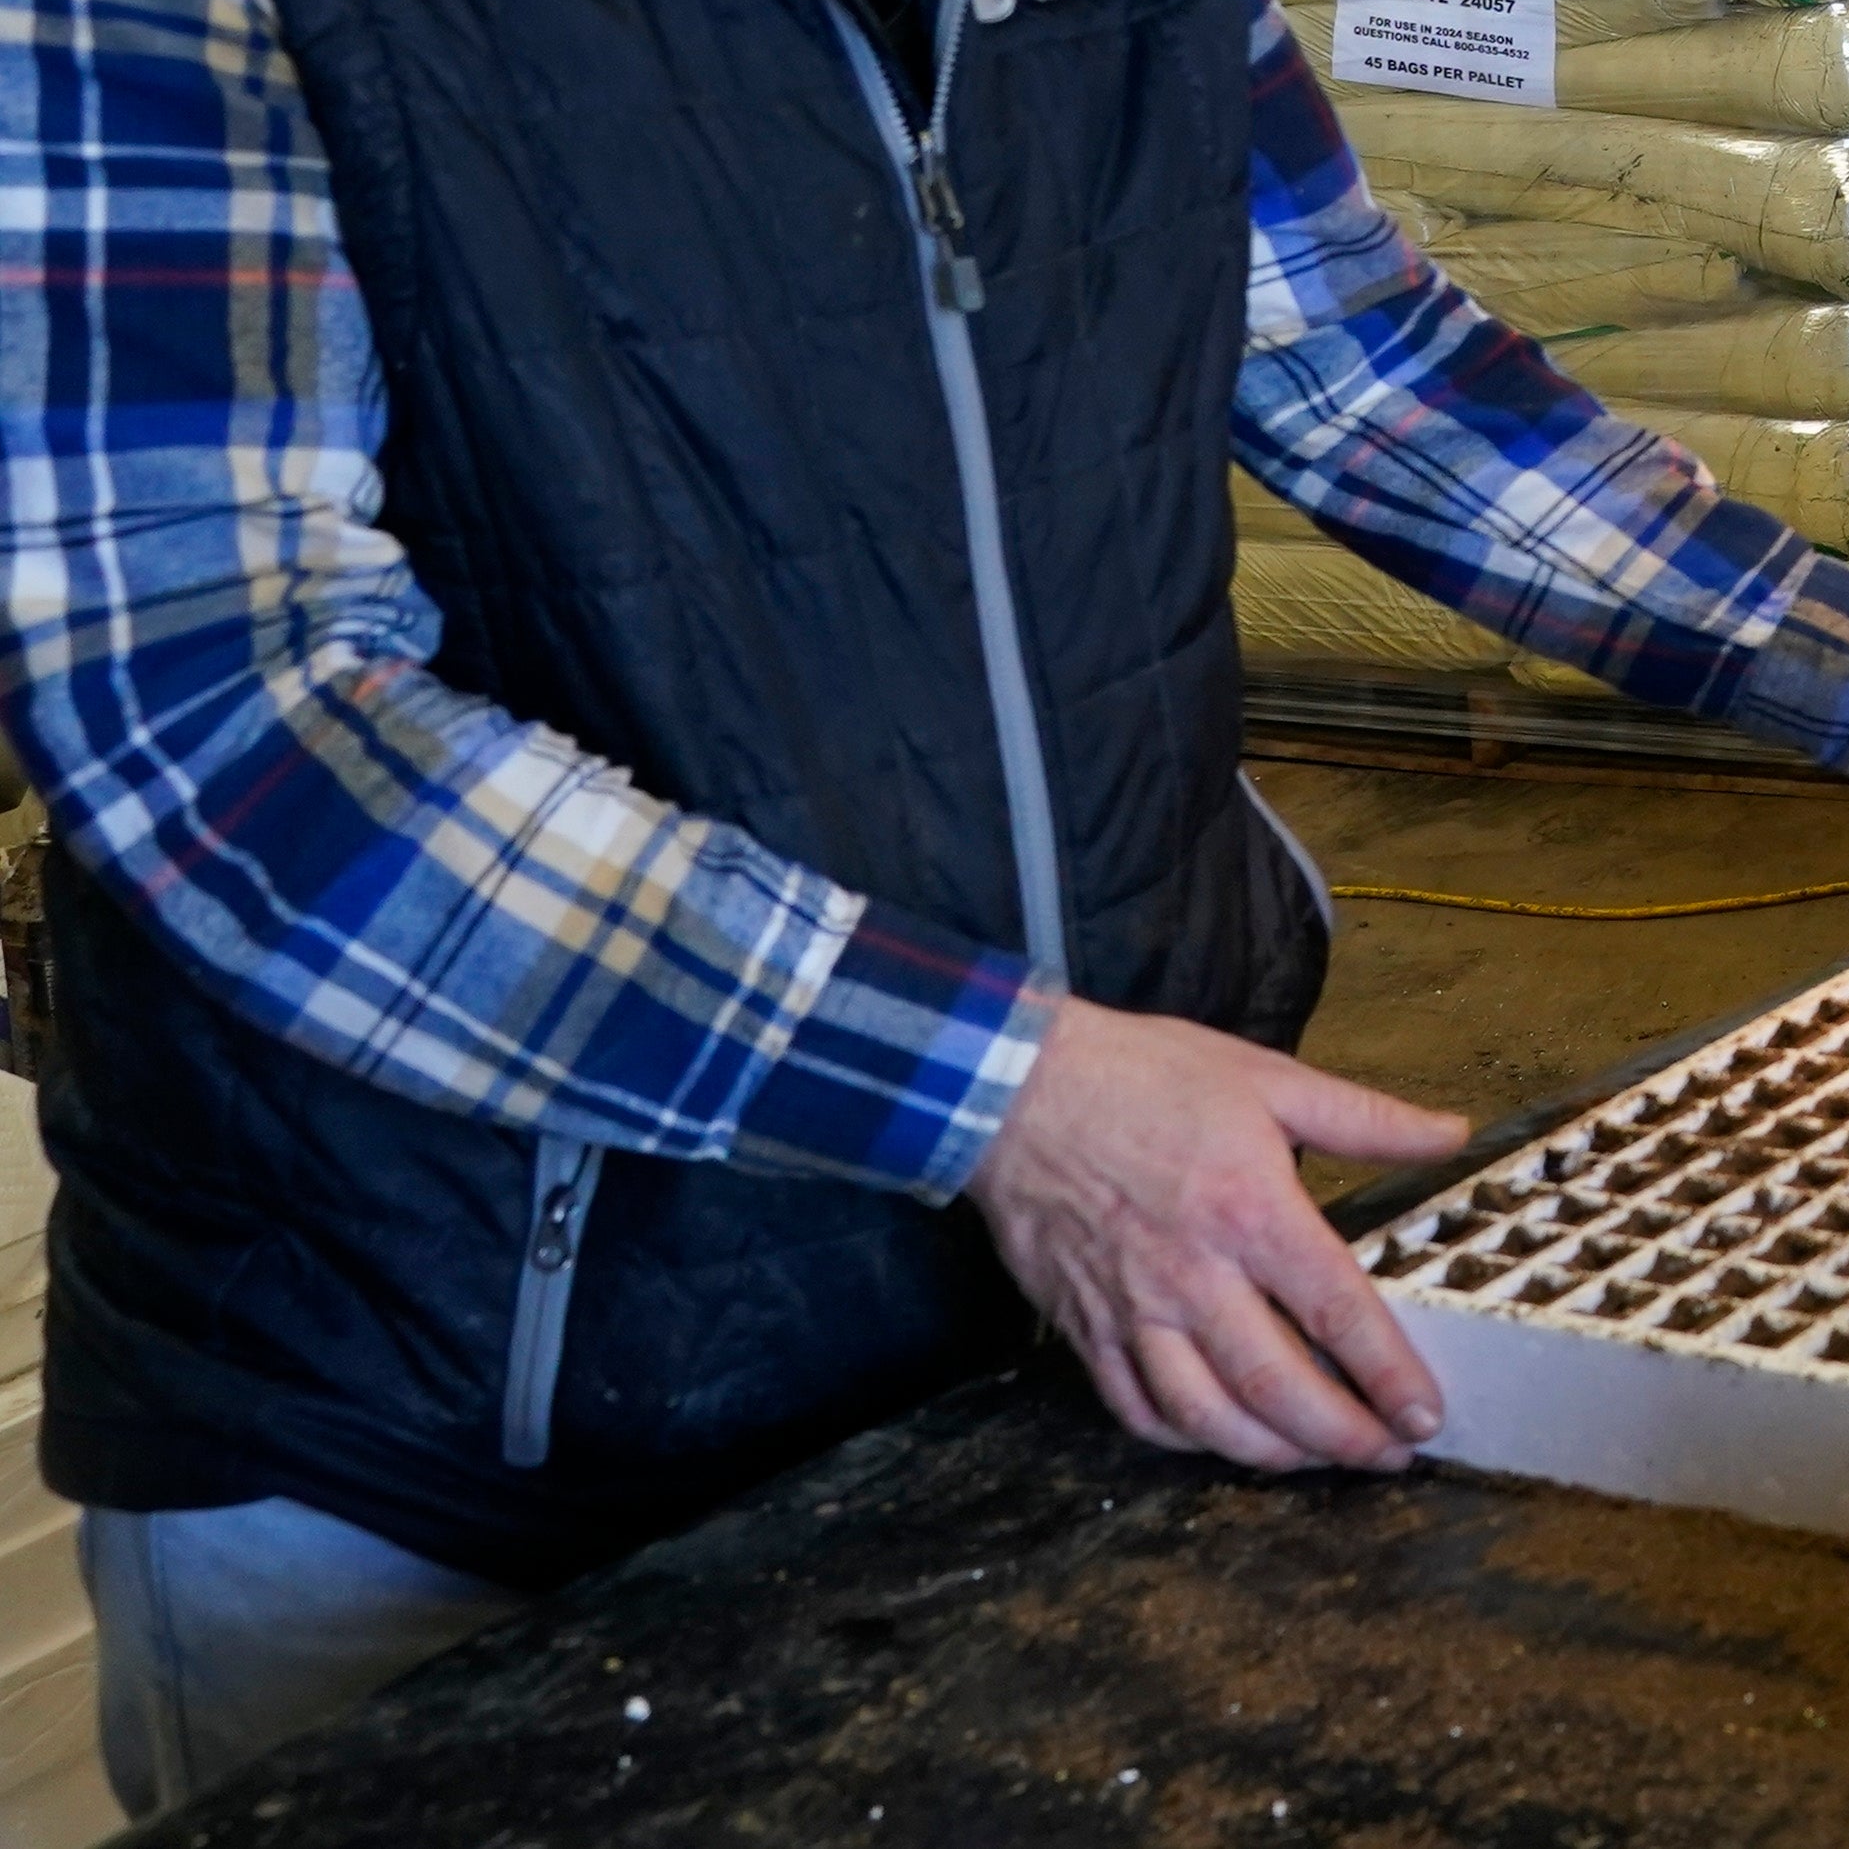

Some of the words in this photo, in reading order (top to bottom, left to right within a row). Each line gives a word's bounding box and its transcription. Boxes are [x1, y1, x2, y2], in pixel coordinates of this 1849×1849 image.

[1353, 25, 1419, 44] QUESTIONS
[1422, 36, 1451, 49] CALL
[1454, 40, 1530, 60] 800-635-4532
[1369, 16, 1391, 28] FOR
[1394, 19, 1417, 32] USE
[1420, 24, 1432, 34] IN
[1435, 26, 1462, 38] 2024
[1466, 31, 1514, 46] SEASON
[1364, 56, 1383, 69] 45
[1387, 59, 1428, 76] BAGS
[1433, 65, 1463, 81] PER
[1469, 71, 1525, 89] PALLET
